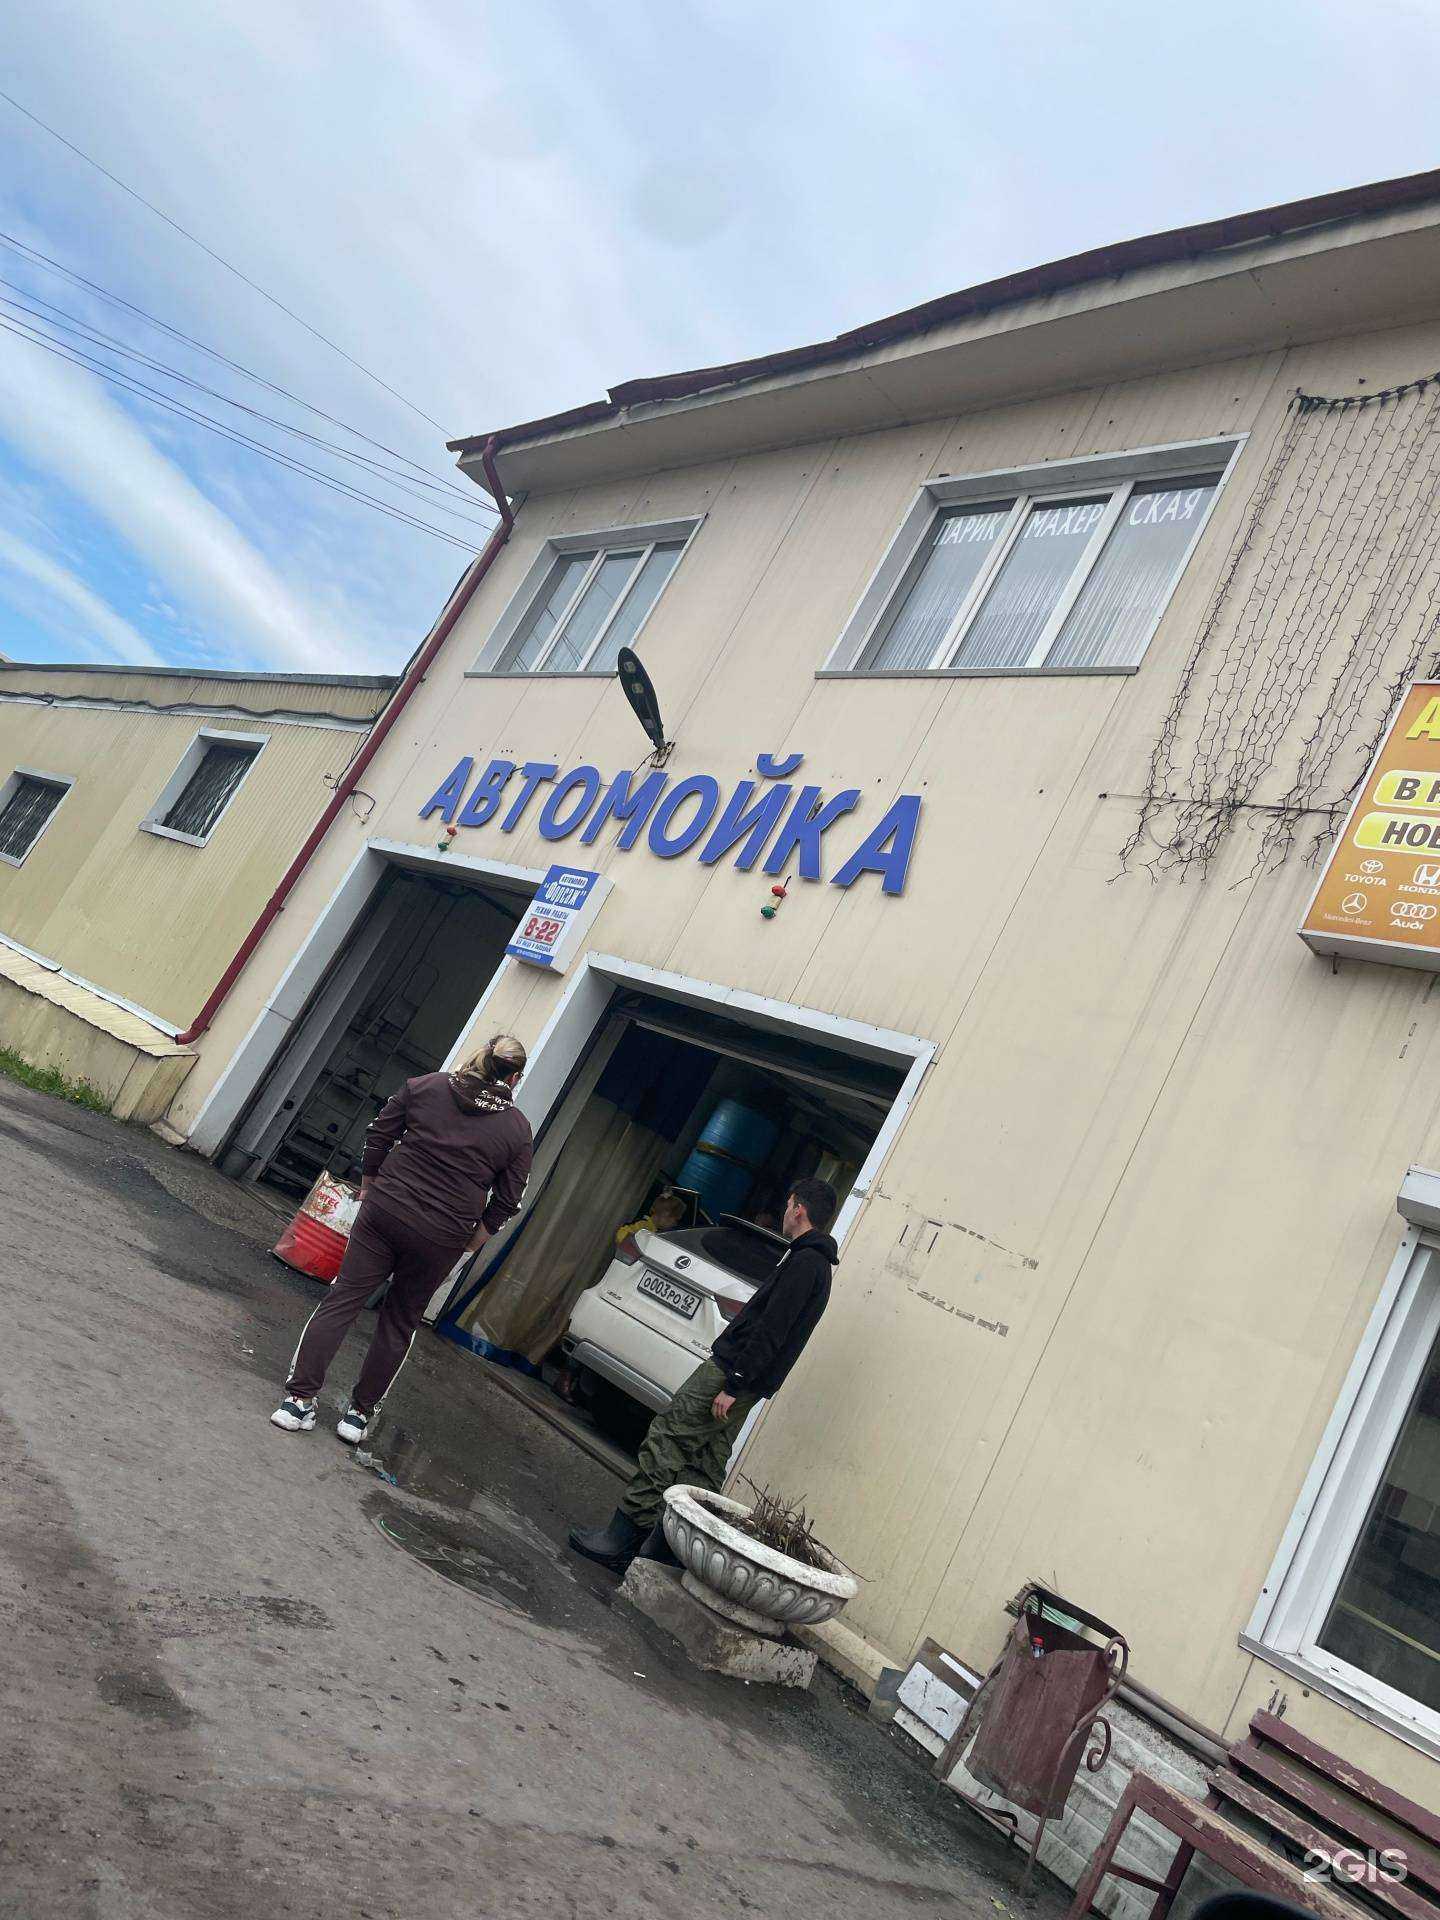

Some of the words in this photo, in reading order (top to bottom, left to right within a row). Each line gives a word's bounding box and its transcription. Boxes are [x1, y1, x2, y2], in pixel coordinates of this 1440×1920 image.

[1023, 506, 1104, 539] МАХЕР
[1129, 487, 1203, 526] СКАЯ
[417, 753, 922, 895] АВТОМОЙКА
[1344, 873, 1387, 886] TOYOTA
[1389, 918, 1424, 930] Audi
